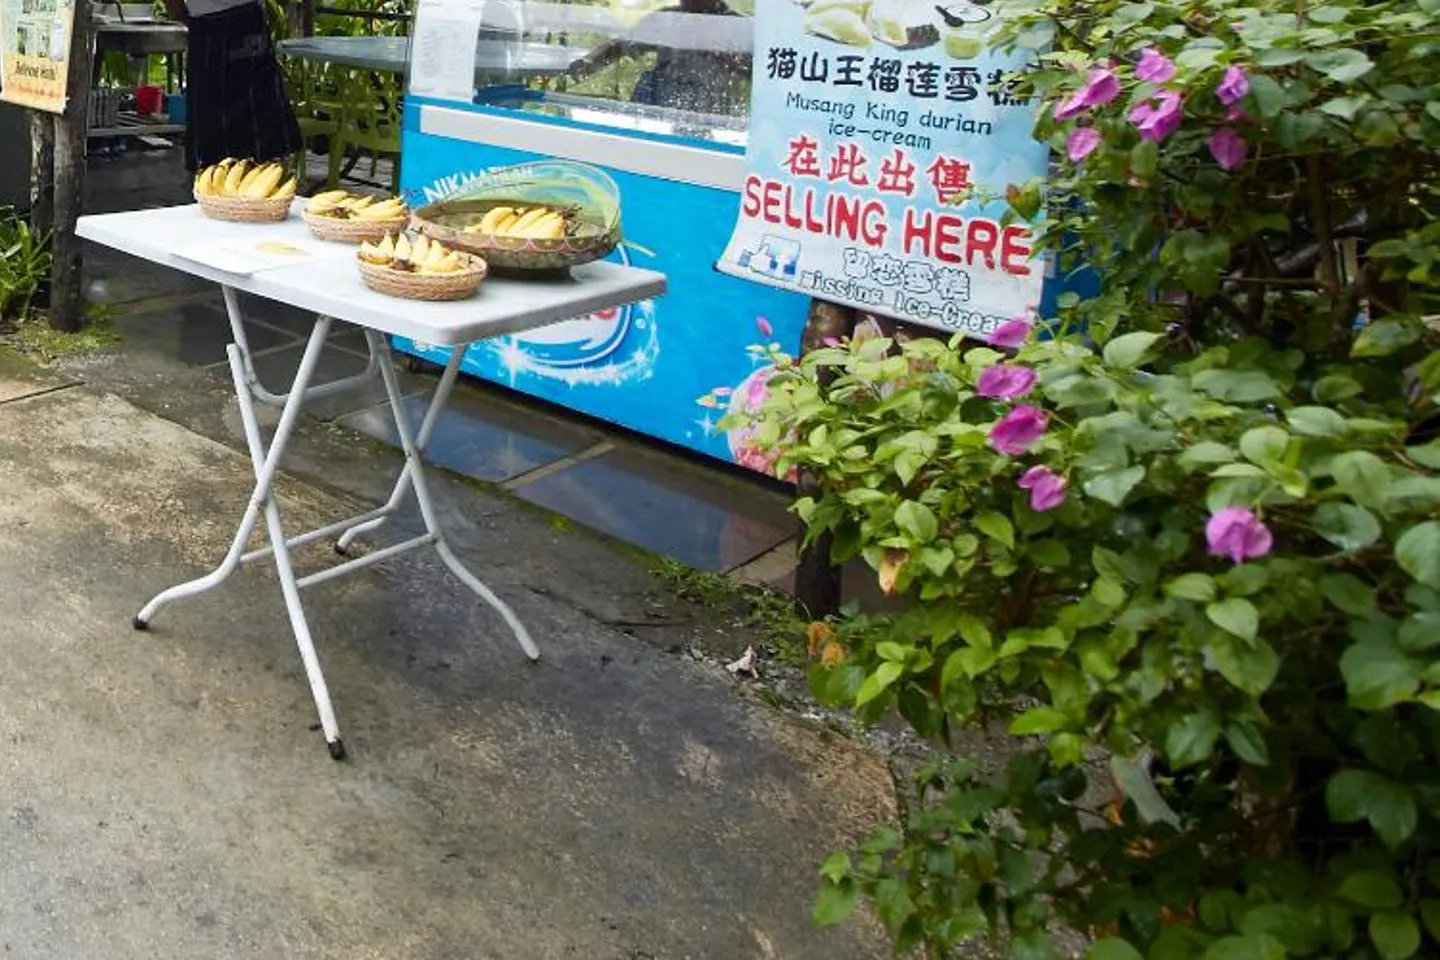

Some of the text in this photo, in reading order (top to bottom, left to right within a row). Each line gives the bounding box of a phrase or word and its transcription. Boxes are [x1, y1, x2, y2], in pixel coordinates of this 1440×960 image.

[786, 91, 992, 136] Musang King durian
[828, 118, 932, 150] ice-cream
[742, 176, 1034, 276] SELLING HERE
